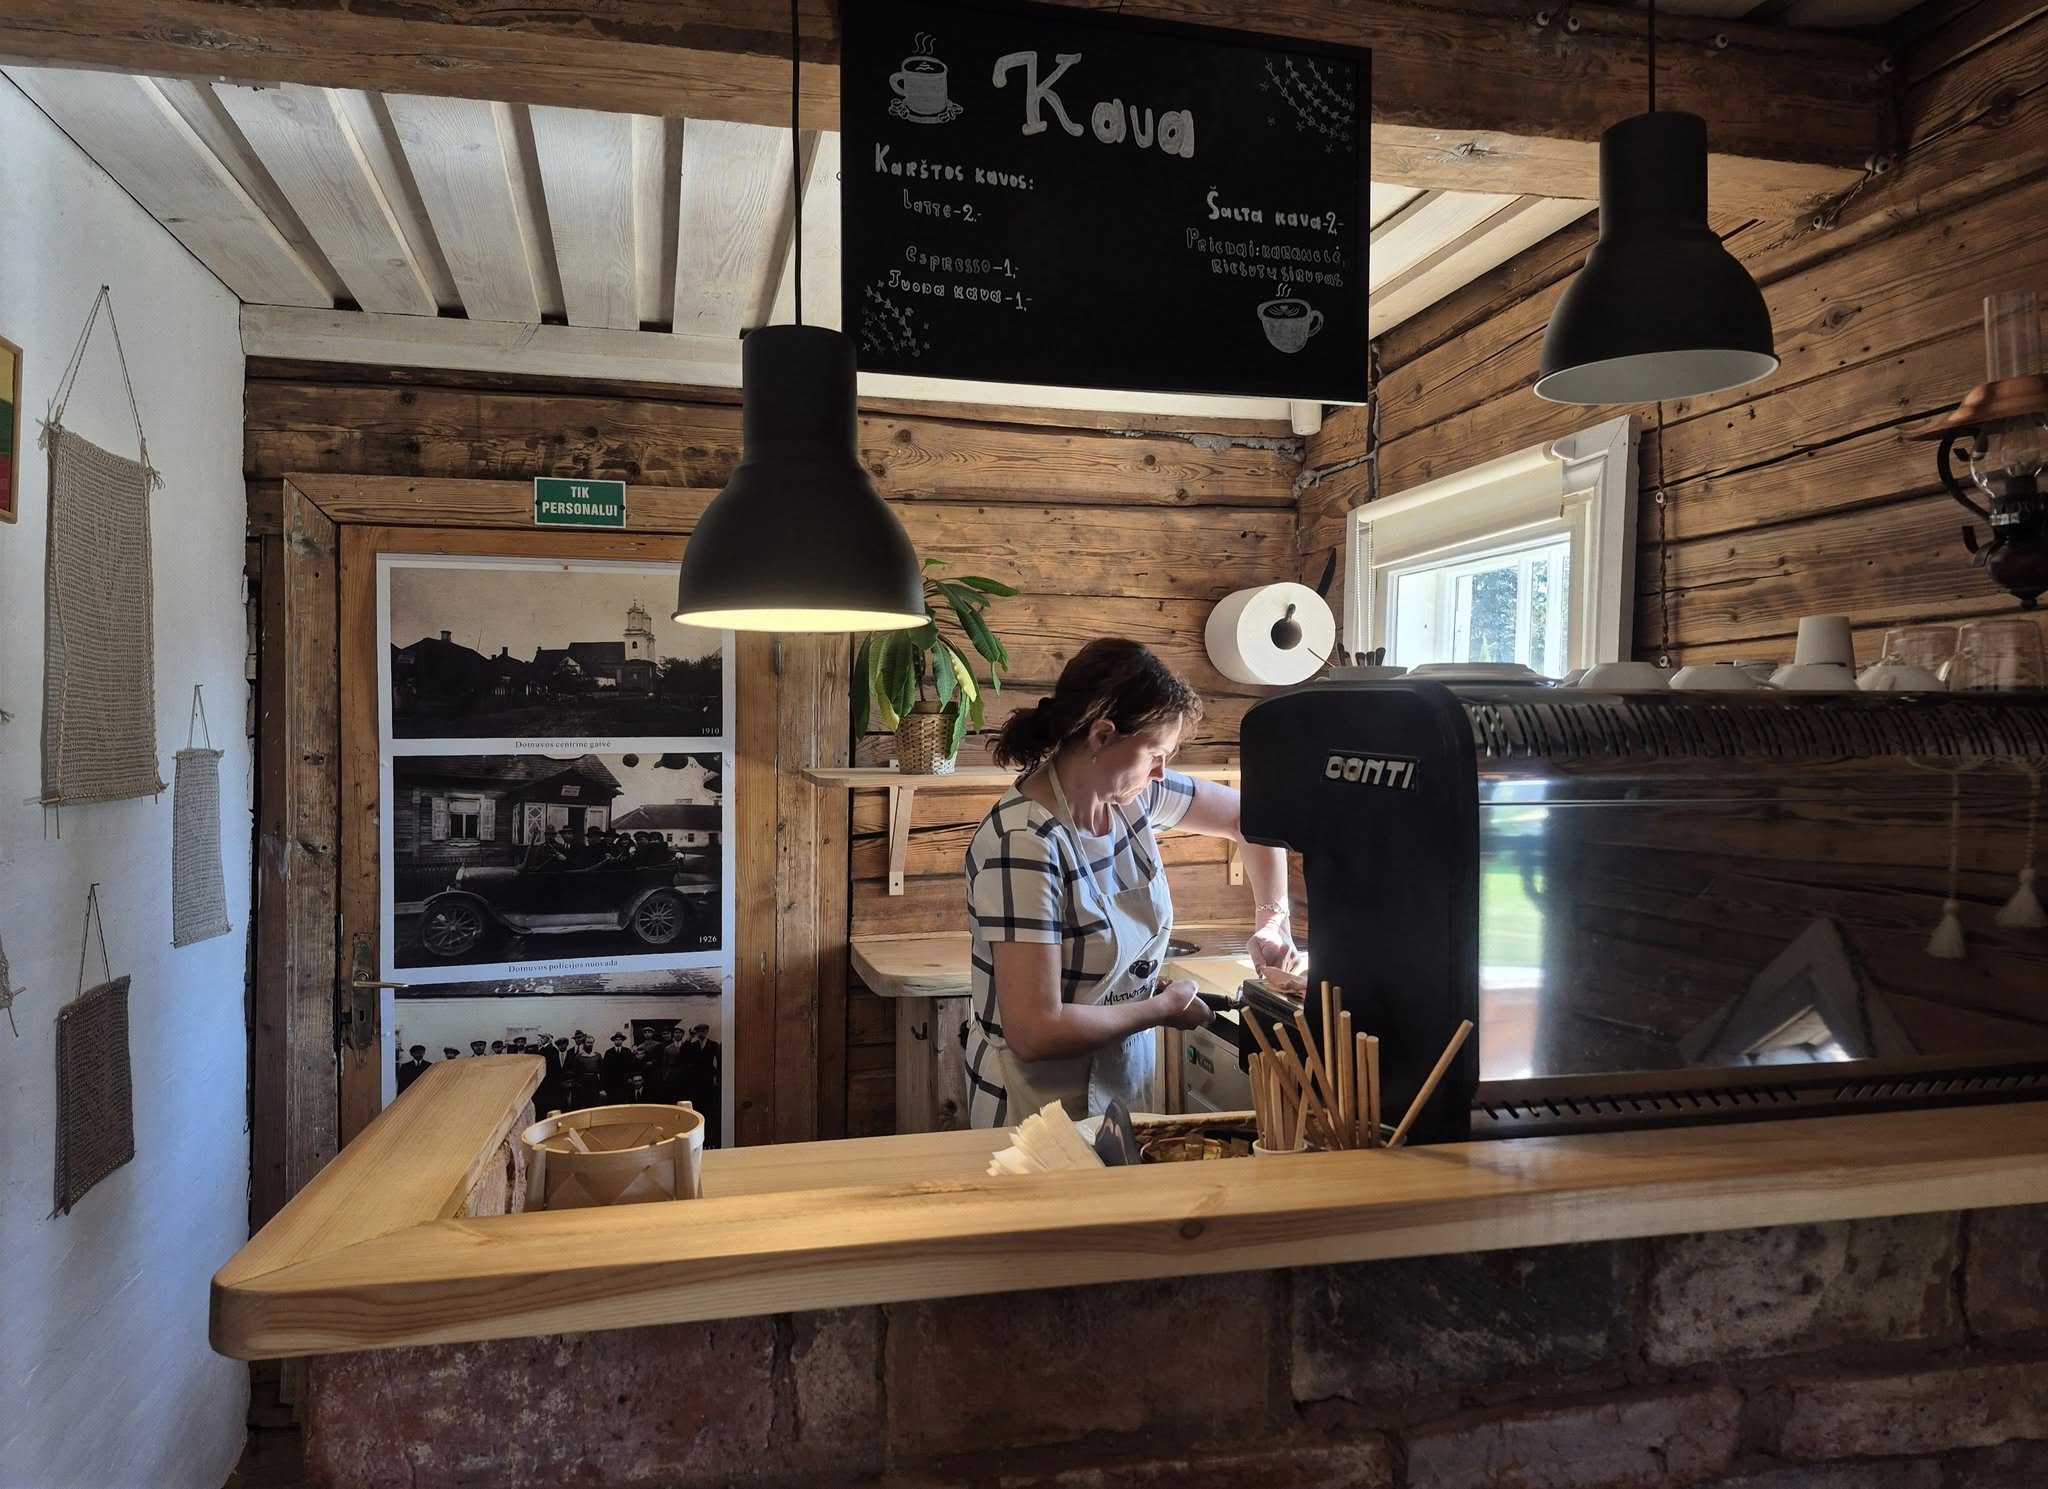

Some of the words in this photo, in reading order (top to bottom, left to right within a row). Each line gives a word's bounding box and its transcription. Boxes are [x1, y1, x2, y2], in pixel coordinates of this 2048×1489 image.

[992, 50, 1195, 159] Kava
[570, 486, 590, 499] TIK
[542, 501, 618, 517] PERSONALUI
[701, 726, 720, 735] 1910
[515, 741, 554, 749] Dotnuvos
[1325, 755, 1415, 789] CONTI
[698, 935, 717, 944] 1926
[508, 963, 547, 973] Dotnuvos
[548, 961, 584, 972] policijos
[585, 959, 618, 969] nuovada
